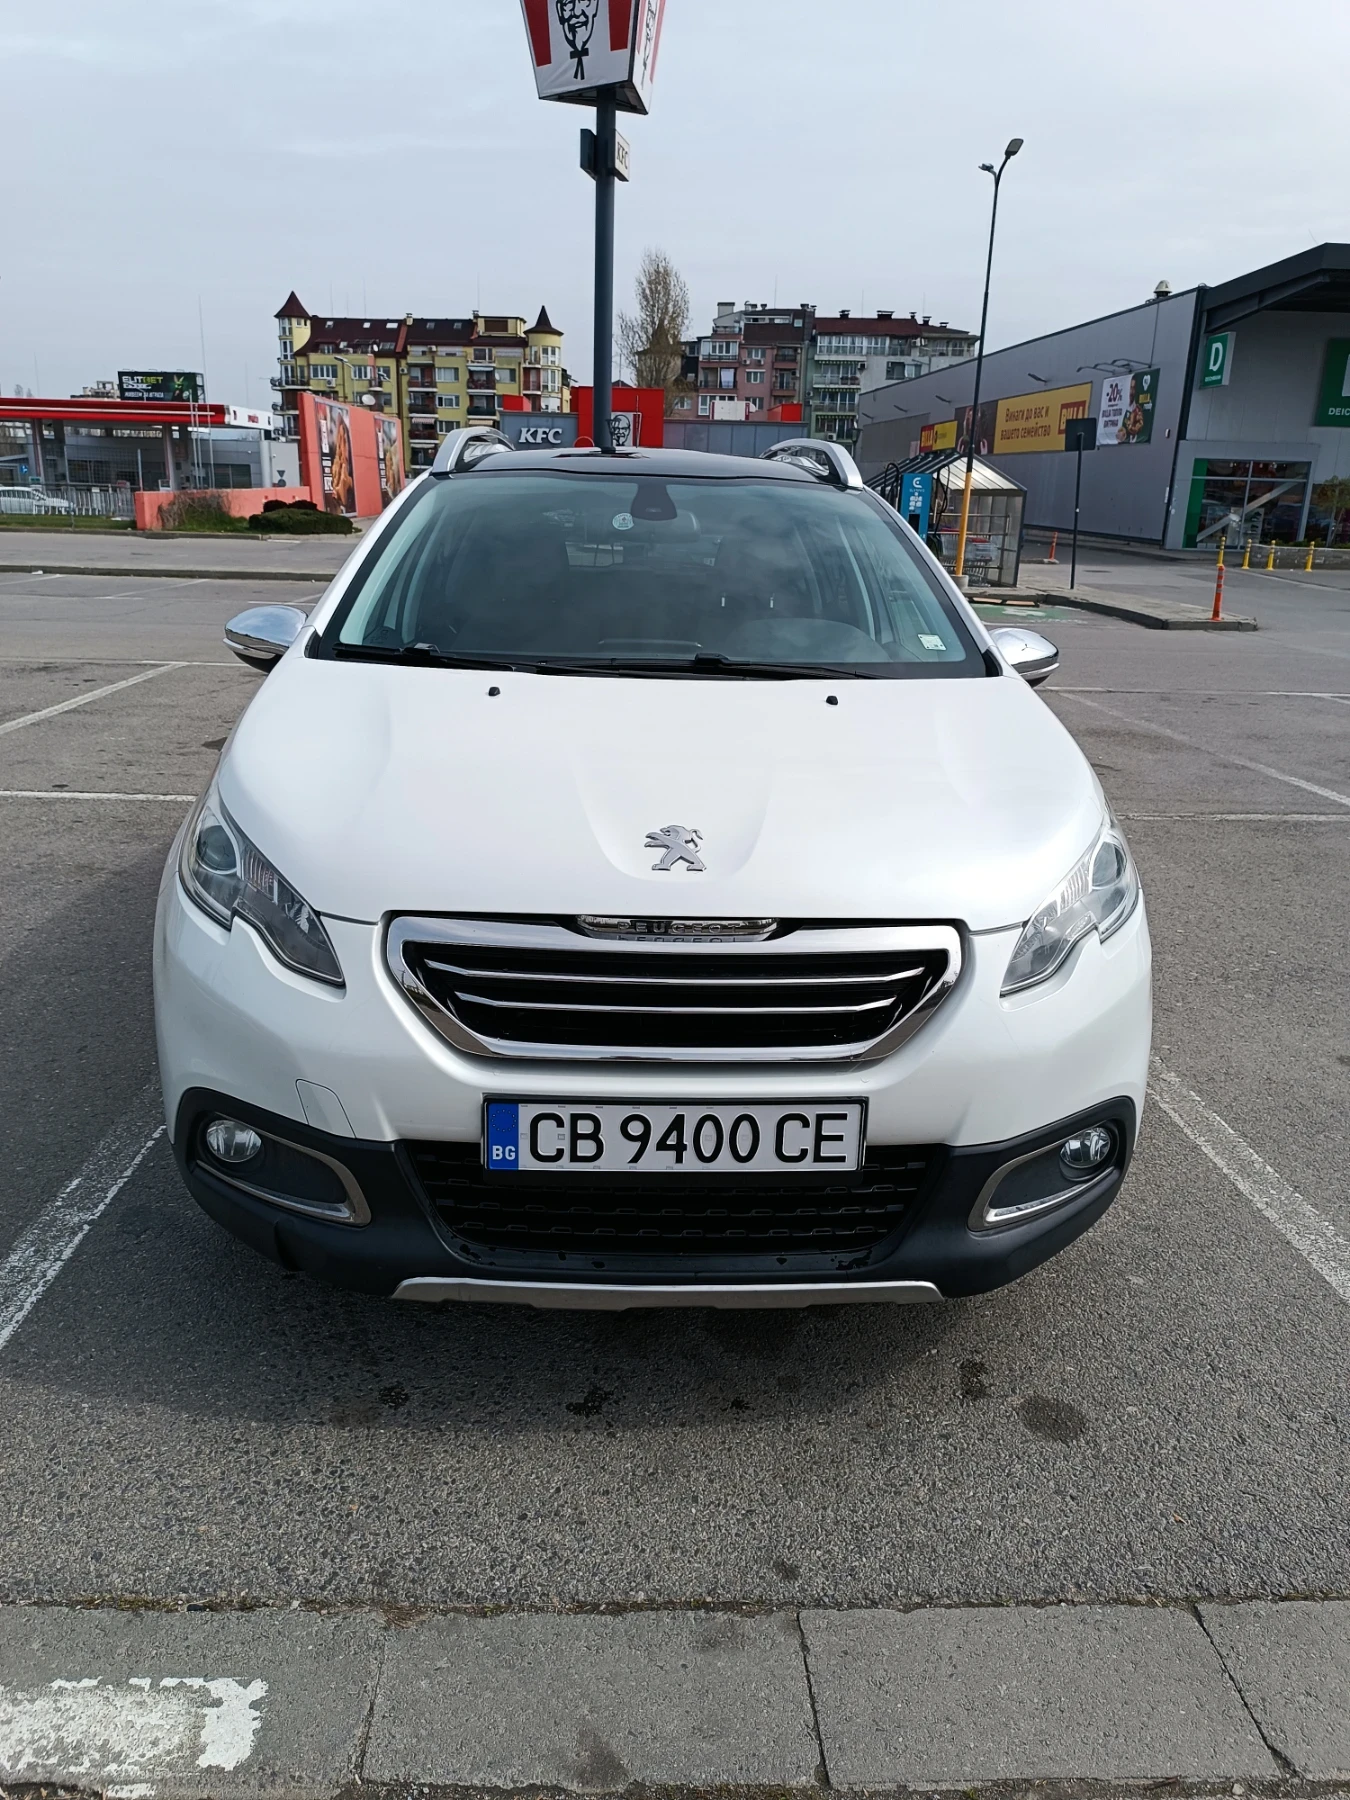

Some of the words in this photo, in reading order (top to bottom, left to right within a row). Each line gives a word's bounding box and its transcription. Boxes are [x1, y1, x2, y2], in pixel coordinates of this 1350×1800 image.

[616, 141, 628, 170] KFC
[1209, 342, 1223, 371] D
[1106, 382, 1123, 402] -20%
[1005, 408, 1025, 423] Винаги
[1025, 408, 1033, 422] до
[1033, 406, 1044, 419] вас
[1045, 406, 1050, 418] и
[518, 427, 563, 444] KFC
[1000, 428, 1020, 441] вашето
[1020, 422, 1051, 439] семейство
[617, 921, 742, 934] PEUGEOT
[529, 1112, 605, 1164] CB
[619, 1113, 761, 1164] 9400
[774, 1112, 849, 1164] CE
[492, 1146, 516, 1161] BG
